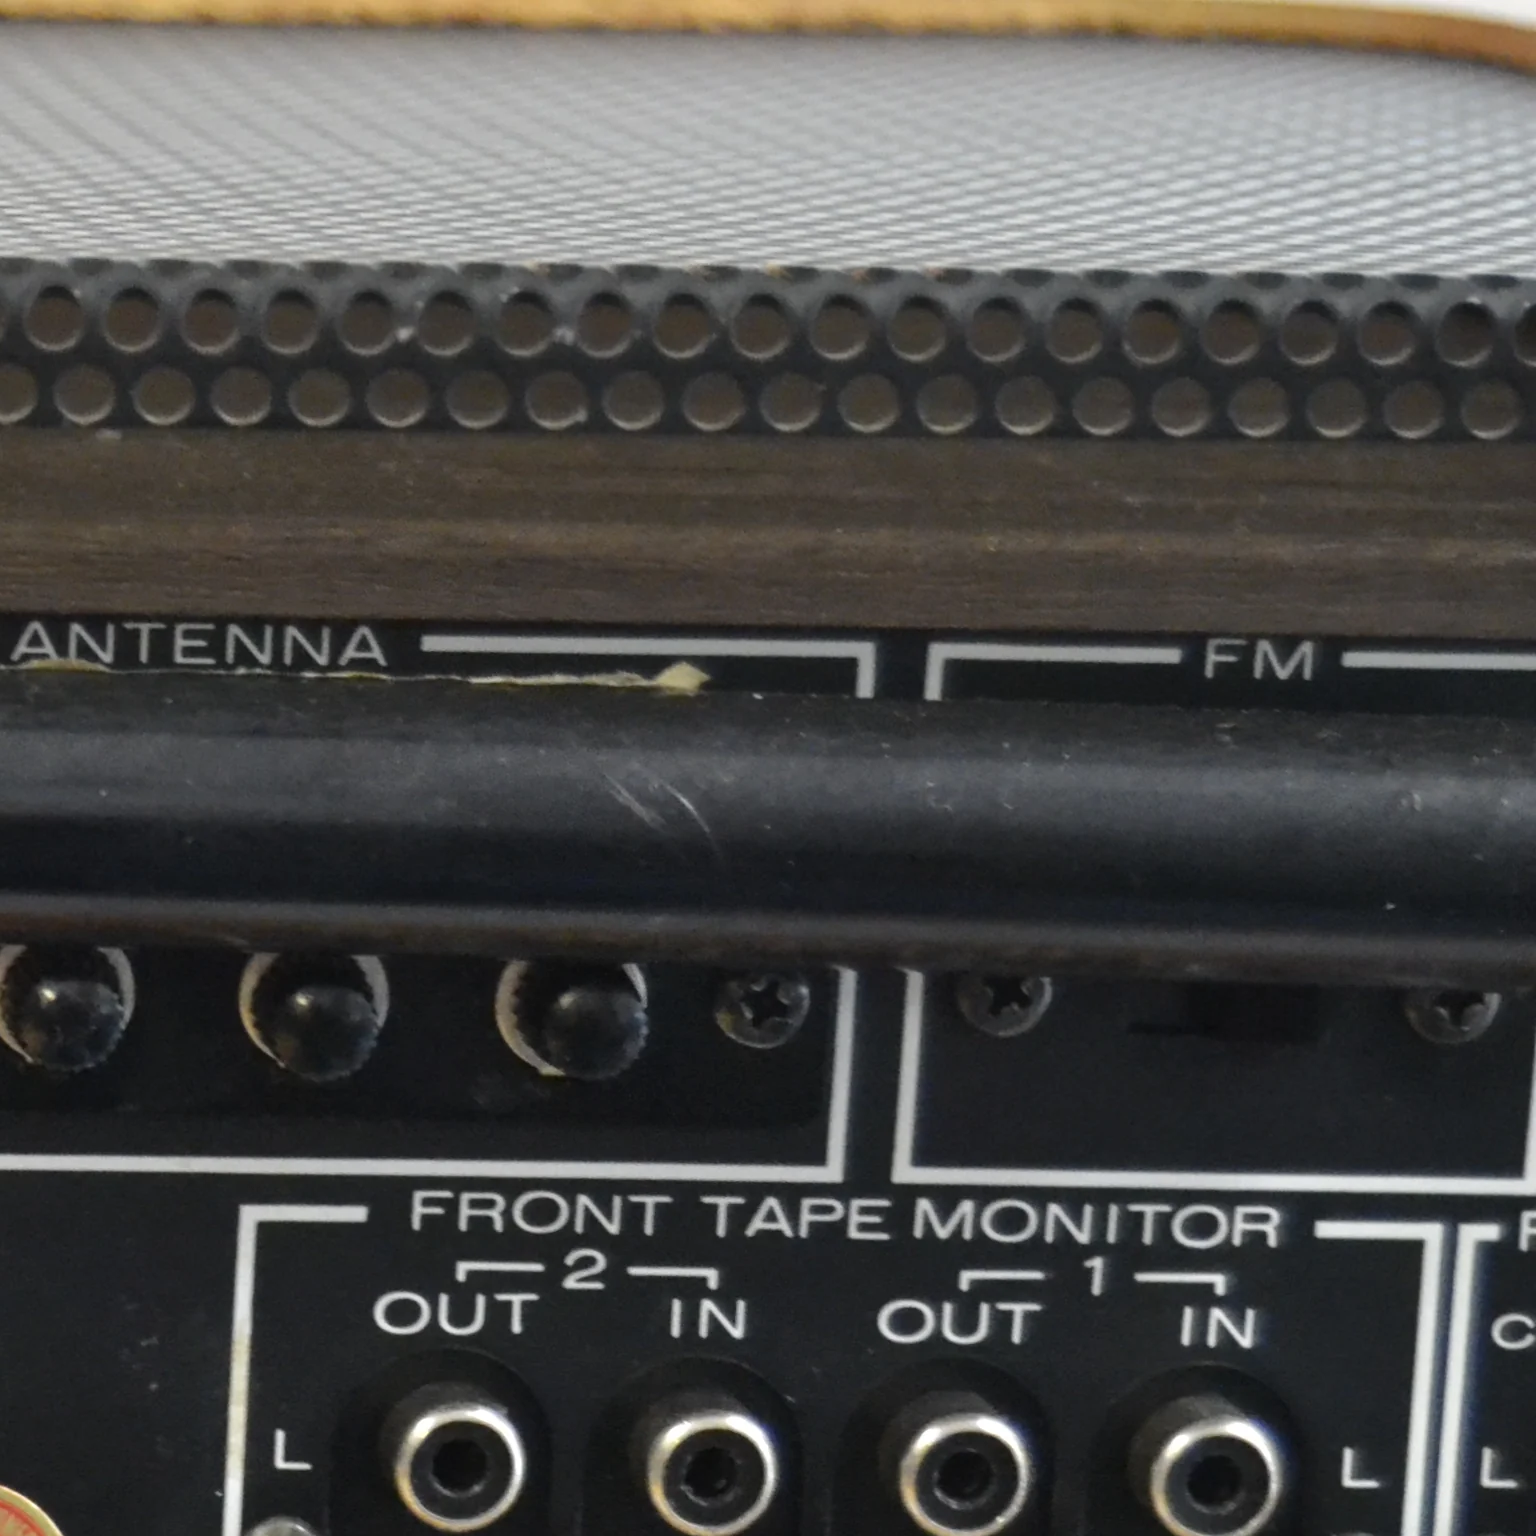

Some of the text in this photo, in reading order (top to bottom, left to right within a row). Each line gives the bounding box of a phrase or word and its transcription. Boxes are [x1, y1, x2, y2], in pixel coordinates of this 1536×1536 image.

[11, 621, 388, 667] ANTENNA
[1204, 638, 1315, 681] FM
[411, 1190, 1283, 1250] FRONT TAPE MONITOR
[562, 1248, 607, 1290] 2
[1083, 1255, 1105, 1297] 1
[373, 1290, 540, 1336] OUT
[670, 1298, 746, 1340] IN
[877, 1299, 1043, 1345] OUT
[1180, 1306, 1256, 1349] IN
[274, 1428, 312, 1470] L
[1341, 1447, 1380, 1489] L
[1479, 1446, 1519, 1489] L
